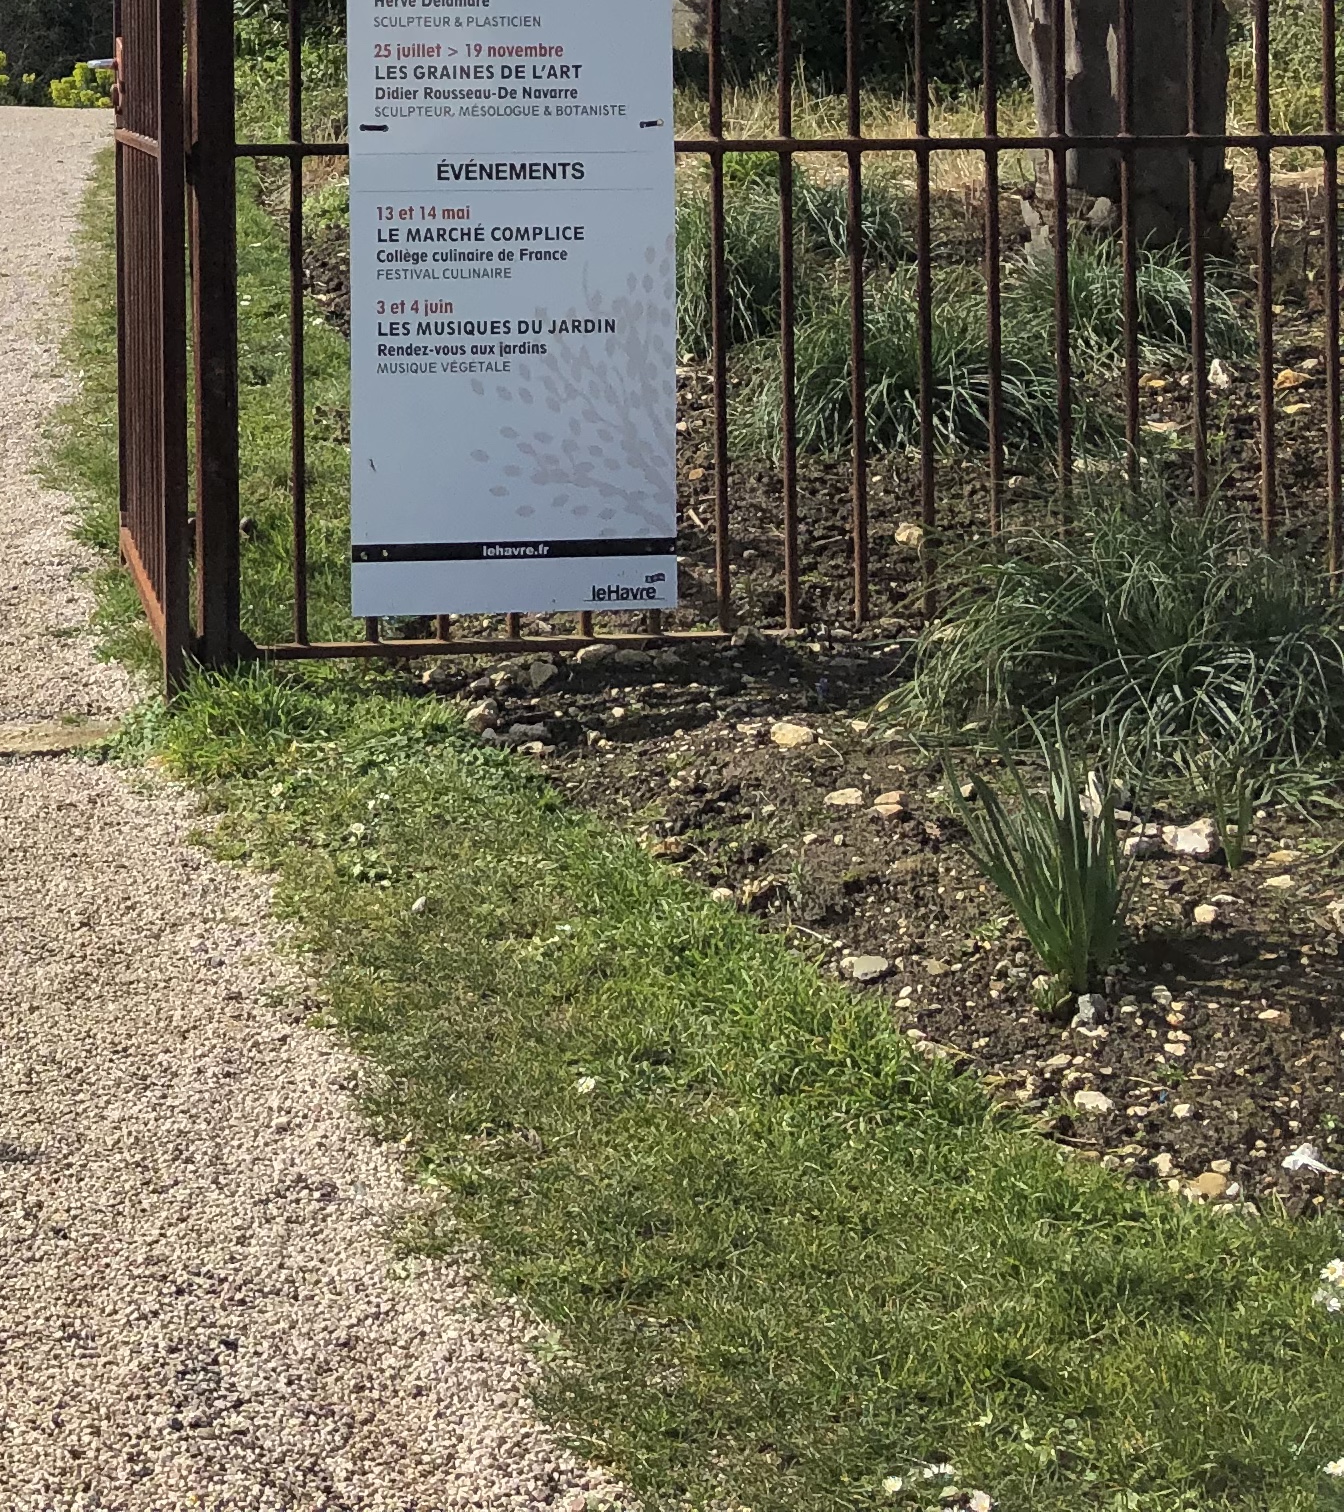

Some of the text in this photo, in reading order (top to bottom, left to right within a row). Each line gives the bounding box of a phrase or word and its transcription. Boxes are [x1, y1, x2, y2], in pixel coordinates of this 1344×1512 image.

[373, 15, 541, 28] SCULPTEUR & PLASTICIEN
[373, 44, 391, 58] 25
[396, 43, 442, 60] juillet
[465, 43, 482, 58] 19
[487, 43, 564, 58] novembre
[375, 65, 408, 80] LES
[413, 65, 495, 80] GRAINES
[500, 64, 526, 80] DE
[375, 86, 578, 100] Didier Rousseau-De Navarre
[374, 103, 626, 118] SCULPTEUR, MÉSOLOGUE & BOTANISTE
[437, 158, 585, 182] ÉVÉNEMENTS
[376, 205, 471, 221] 13 et 14 mai
[377, 223, 585, 243] LE MARCHÉ COMPLICE
[376, 248, 568, 265] Collège culinaire de France
[376, 267, 512, 280] FESTIVAL CULINAIRE
[376, 299, 453, 317] 3 et 4 juin
[377, 319, 617, 336] LES MUSIQUES DU JARDIN
[377, 342, 548, 357] Rendez-vous aux jardins
[376, 359, 511, 374] MUSIQUE VÉGÉTALE
[482, 544, 550, 557] lehavre.fr
[592, 584, 657, 601] leHavre
